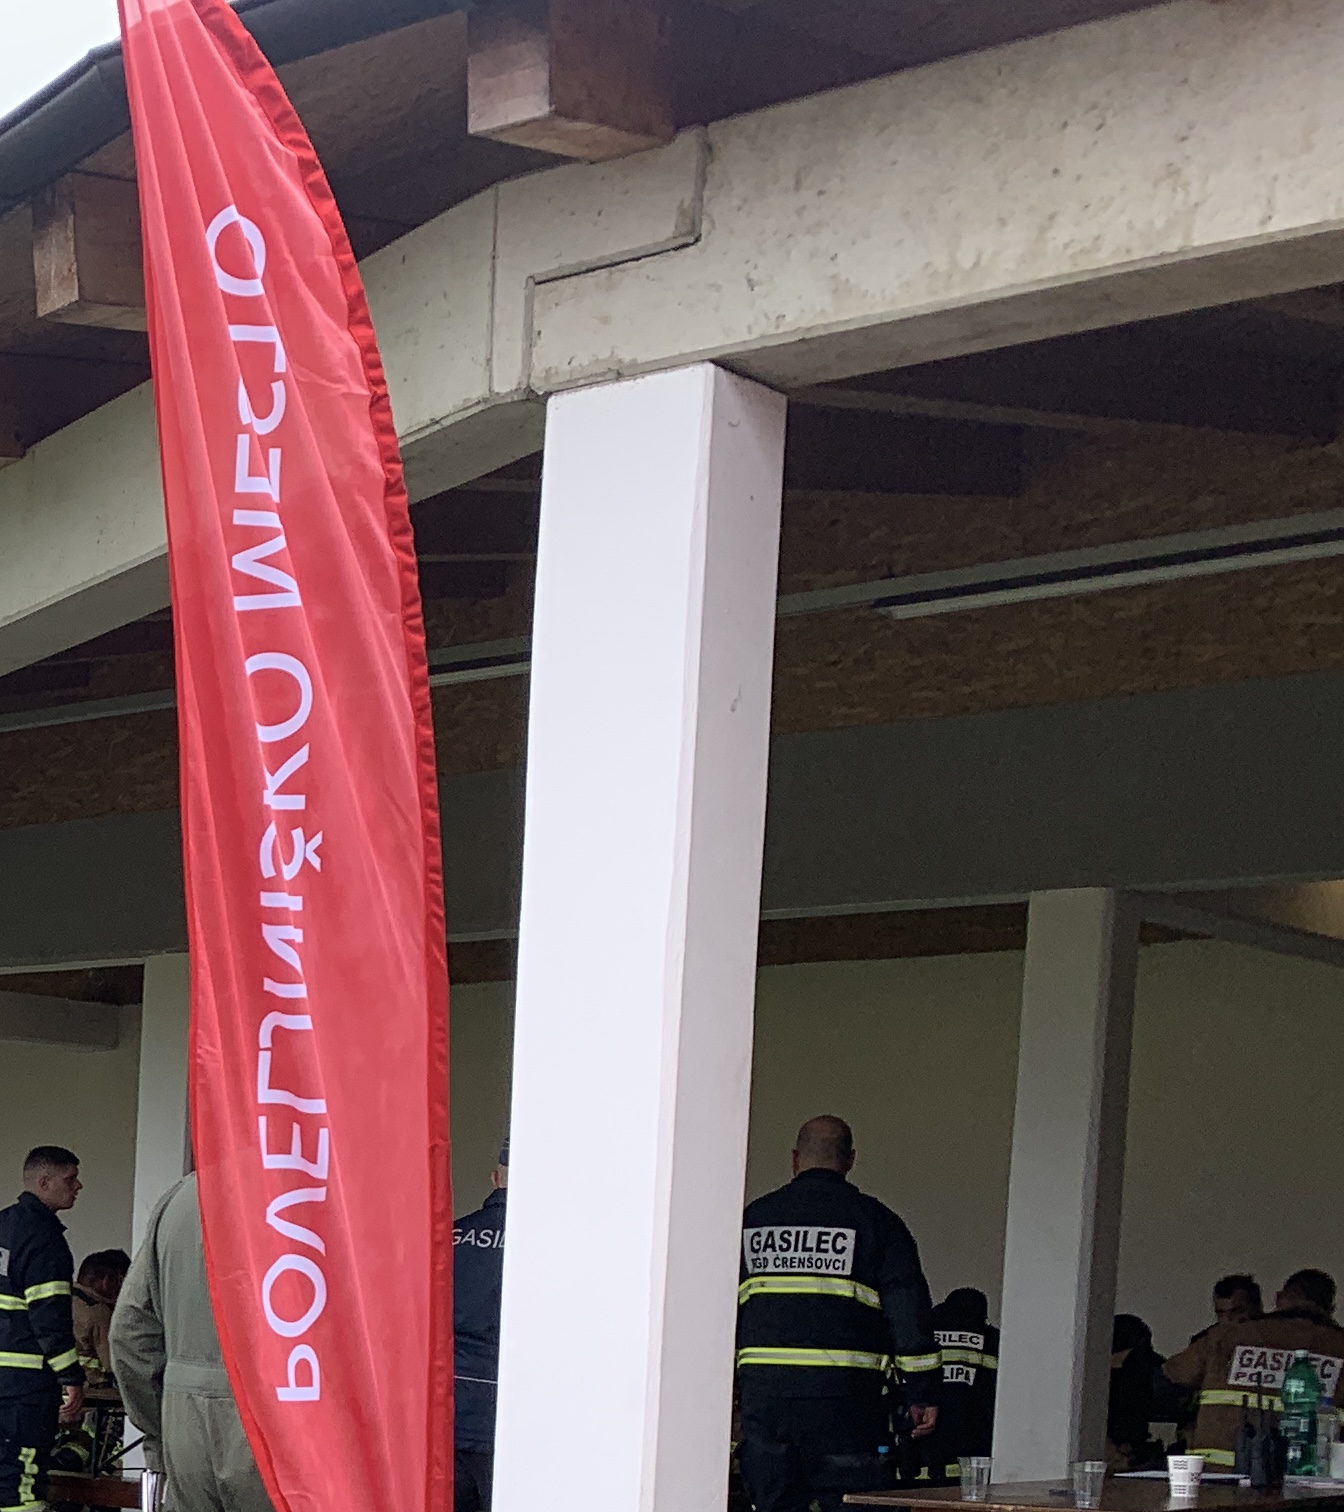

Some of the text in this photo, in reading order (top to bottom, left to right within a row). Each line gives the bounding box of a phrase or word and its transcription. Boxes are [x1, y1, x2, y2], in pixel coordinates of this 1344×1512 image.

[452, 1229, 506, 1248] GASIL
[750, 1230, 848, 1254] GASILEC
[773, 1254, 845, 1271] ČRENŠOVCI
[934, 1333, 980, 1345] SILEC
